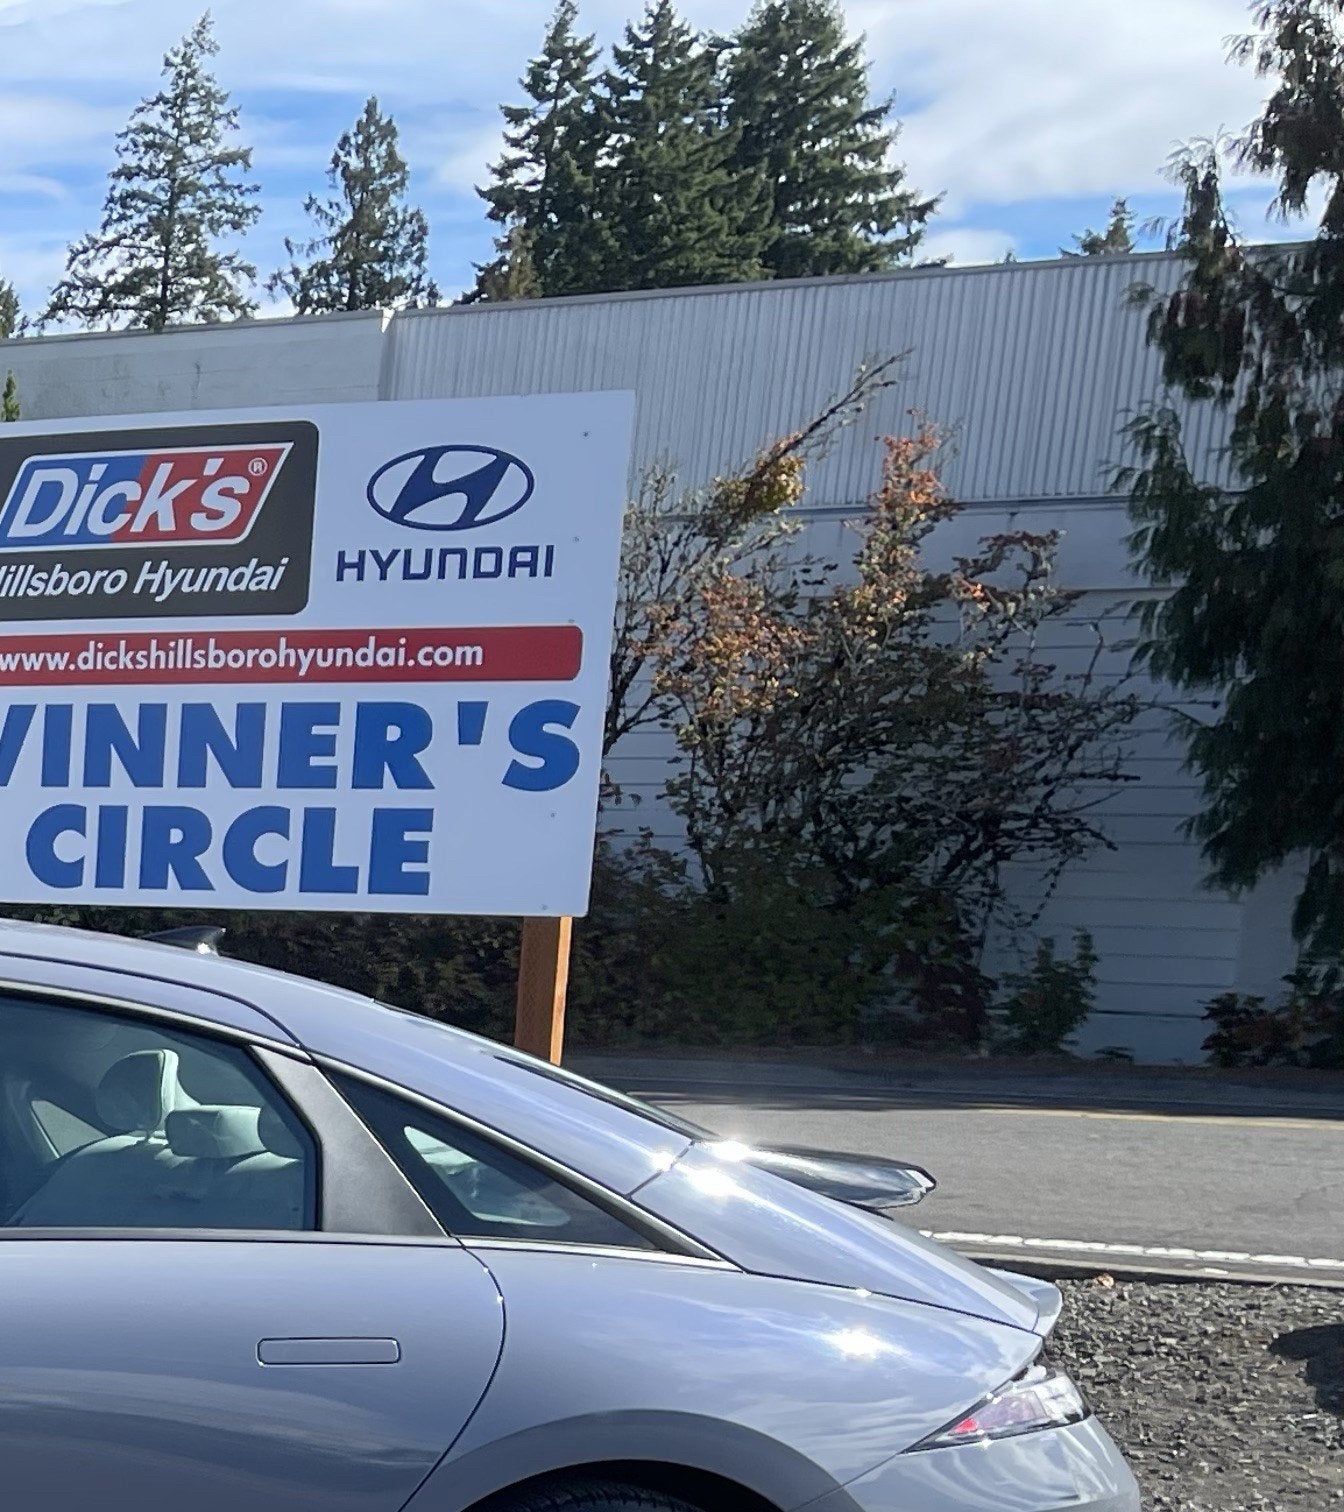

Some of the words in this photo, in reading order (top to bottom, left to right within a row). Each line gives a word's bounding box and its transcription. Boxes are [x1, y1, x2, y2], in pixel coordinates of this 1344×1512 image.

[7, 457, 251, 538] Dick's
[133, 557, 289, 602] Hyundai
[336, 544, 554, 582] HYUNDAI
[26, 804, 434, 896] CIRCLE
